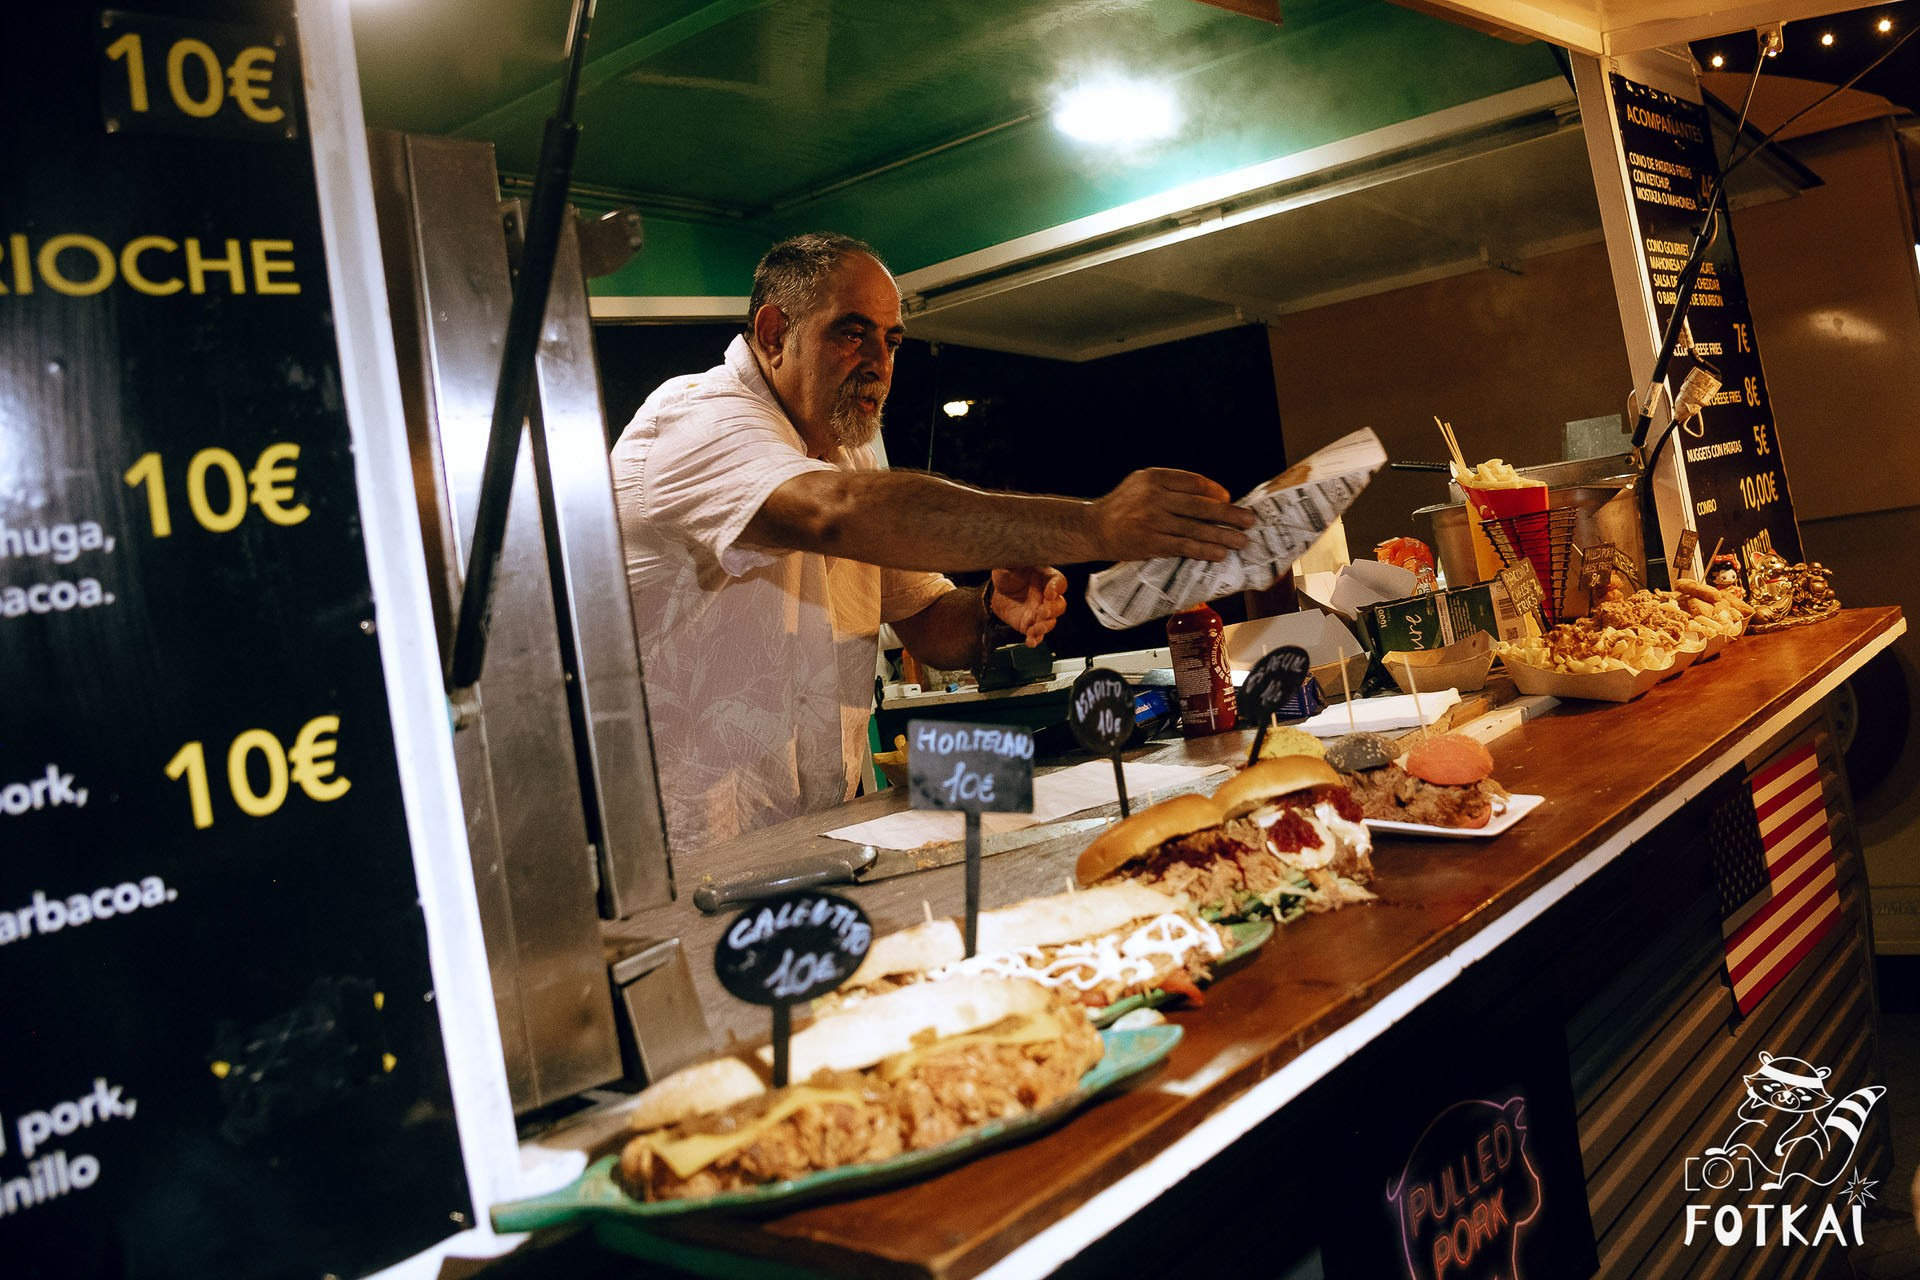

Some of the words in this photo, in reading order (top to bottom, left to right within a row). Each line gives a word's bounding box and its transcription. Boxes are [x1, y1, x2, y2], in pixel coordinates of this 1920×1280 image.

[105, 32, 286, 123] 10€
[1627, 104, 1704, 143] ACOMPAÑANTES
[1629, 152, 1646, 169] CONO
[1646, 157, 1655, 170] DE
[1633, 169, 1647, 183] CON
[1635, 186, 1662, 204] MOSTAZA
[1668, 194, 1697, 211] MAHONESA
[1646, 239, 1662, 253] CONO
[1649, 256, 1680, 271] MAHONESA
[1653, 273, 1671, 287] SALSA
[1733, 323, 1750, 353] 7€
[1744, 376, 1760, 407] 8€
[1686, 445, 1712, 463] NUGGETS
[1711, 443, 1723, 457] CON
[1723, 440, 1742, 455] PATATAS
[1753, 424, 1770, 456] 5€
[123, 441, 311, 539] 10€
[1696, 498, 1717, 516] COMBO
[1740, 471, 1779, 511] 10,00€
[1405, 614, 1424, 650] ure
[0, 763, 88, 816] ork,
[165, 714, 352, 830] 10€
[17, 1076, 138, 1160] pork,
[0, 1151, 100, 1217] nillo
[1409, 1124, 1512, 1238] PULLED
[1433, 1187, 1508, 1280] PORK
